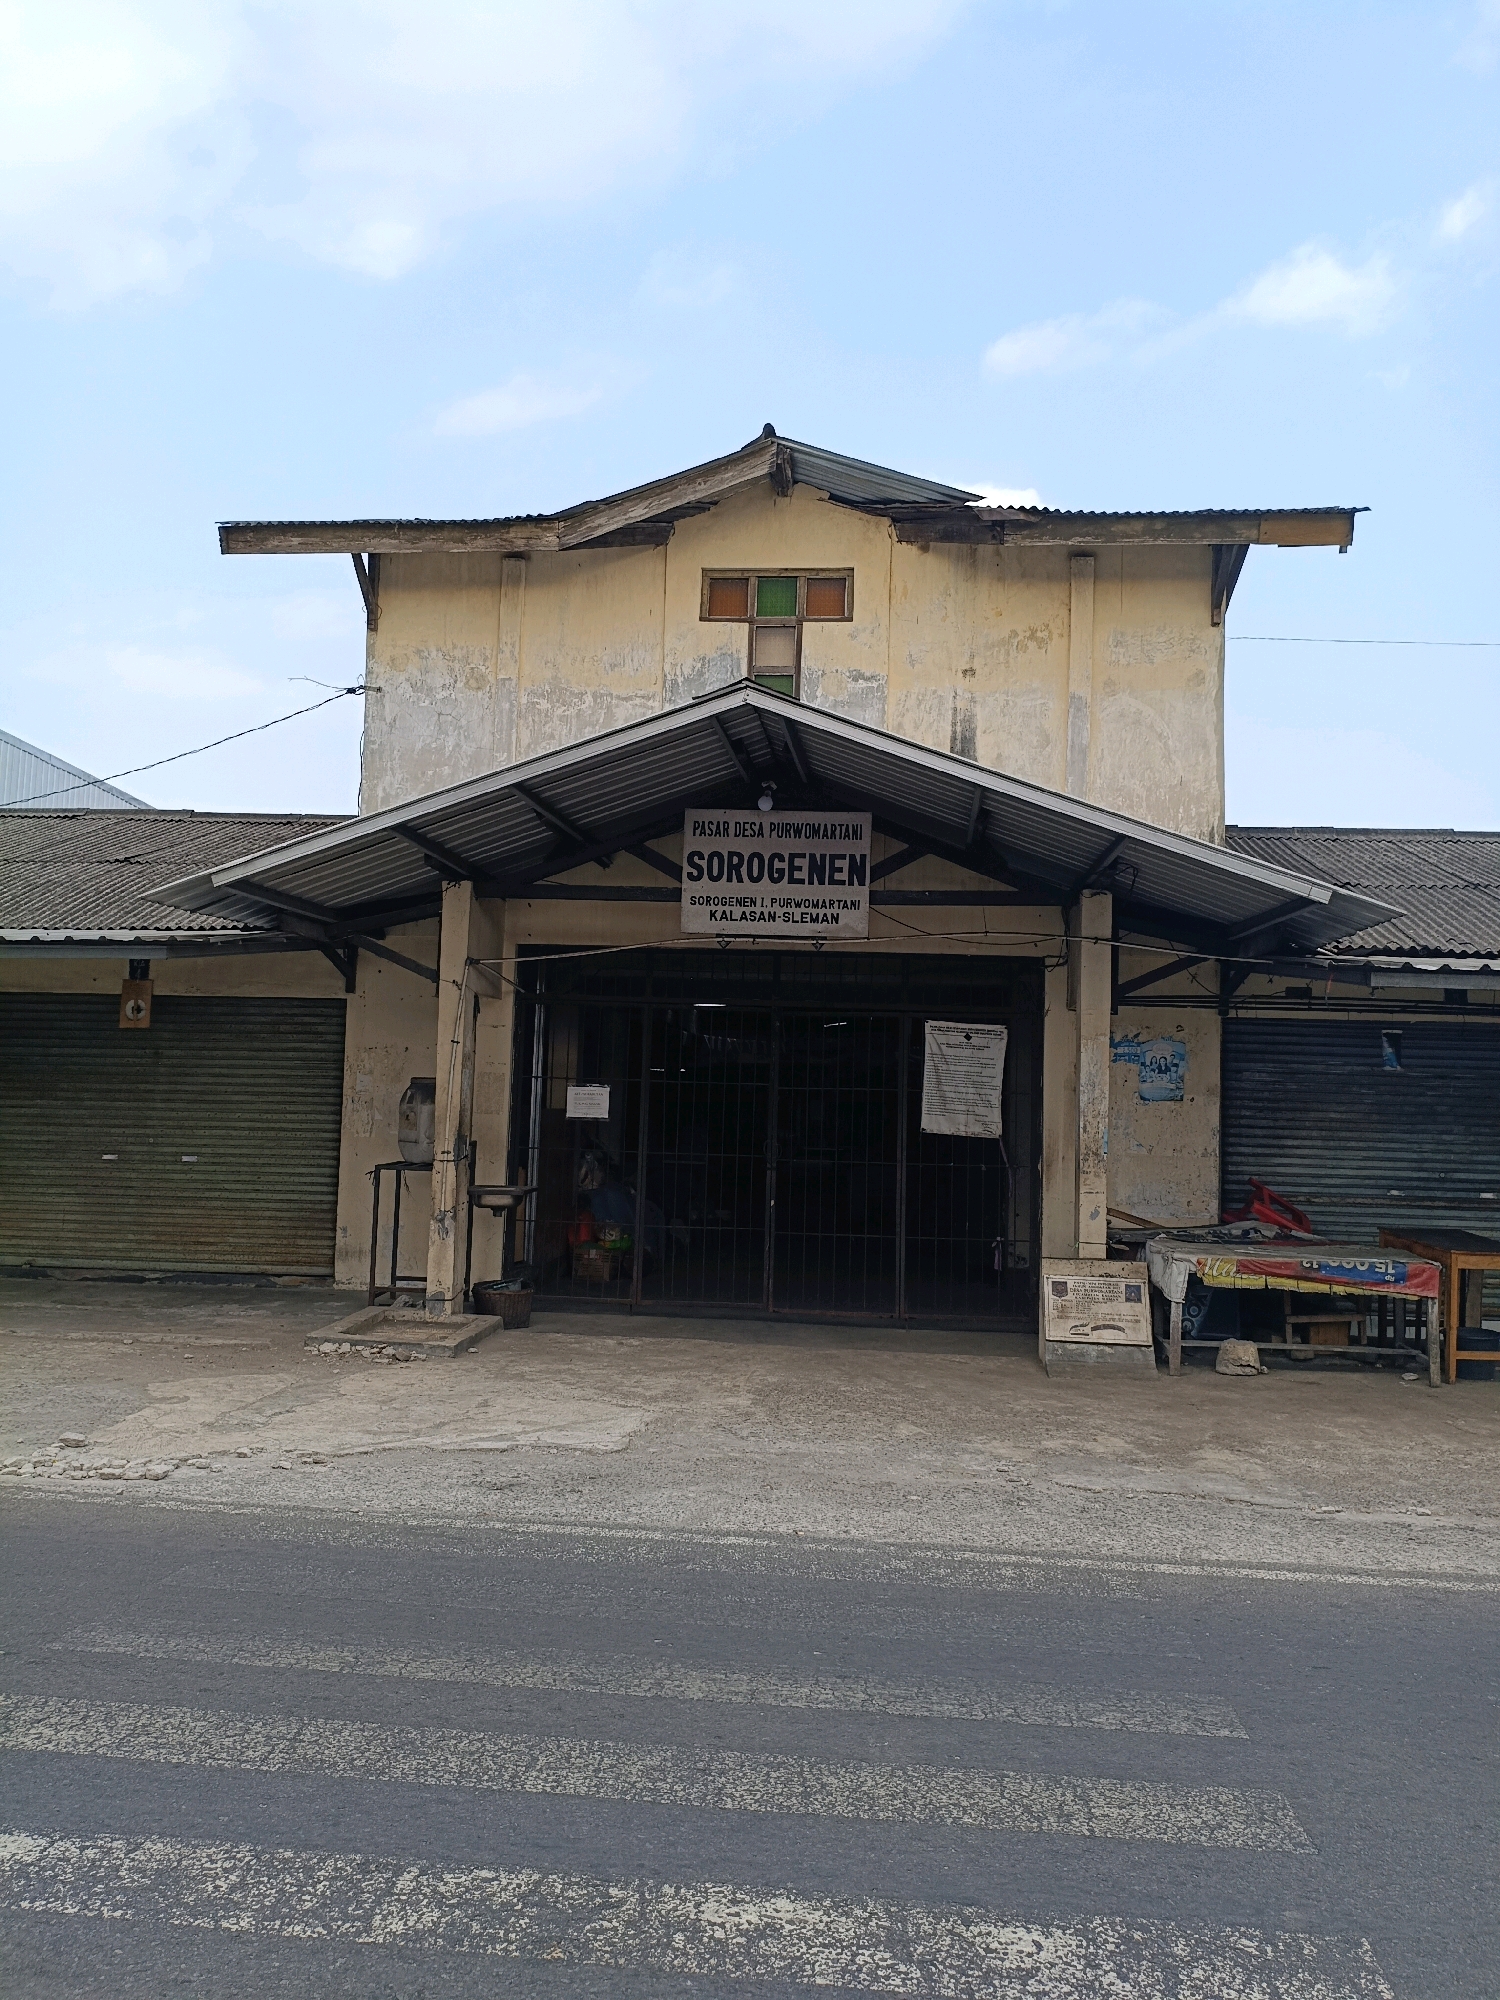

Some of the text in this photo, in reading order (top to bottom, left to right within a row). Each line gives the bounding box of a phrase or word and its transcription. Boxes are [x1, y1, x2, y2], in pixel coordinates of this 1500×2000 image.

[692, 820, 863, 841] PASAR DESA PURWOMARTANI
[686, 850, 867, 887] SOROGENEN
[689, 895, 757, 908] SOROGENEN
[770, 897, 861, 911] PURWOMARTANI
[709, 909, 840, 925] KALASAN-SLEMAN
